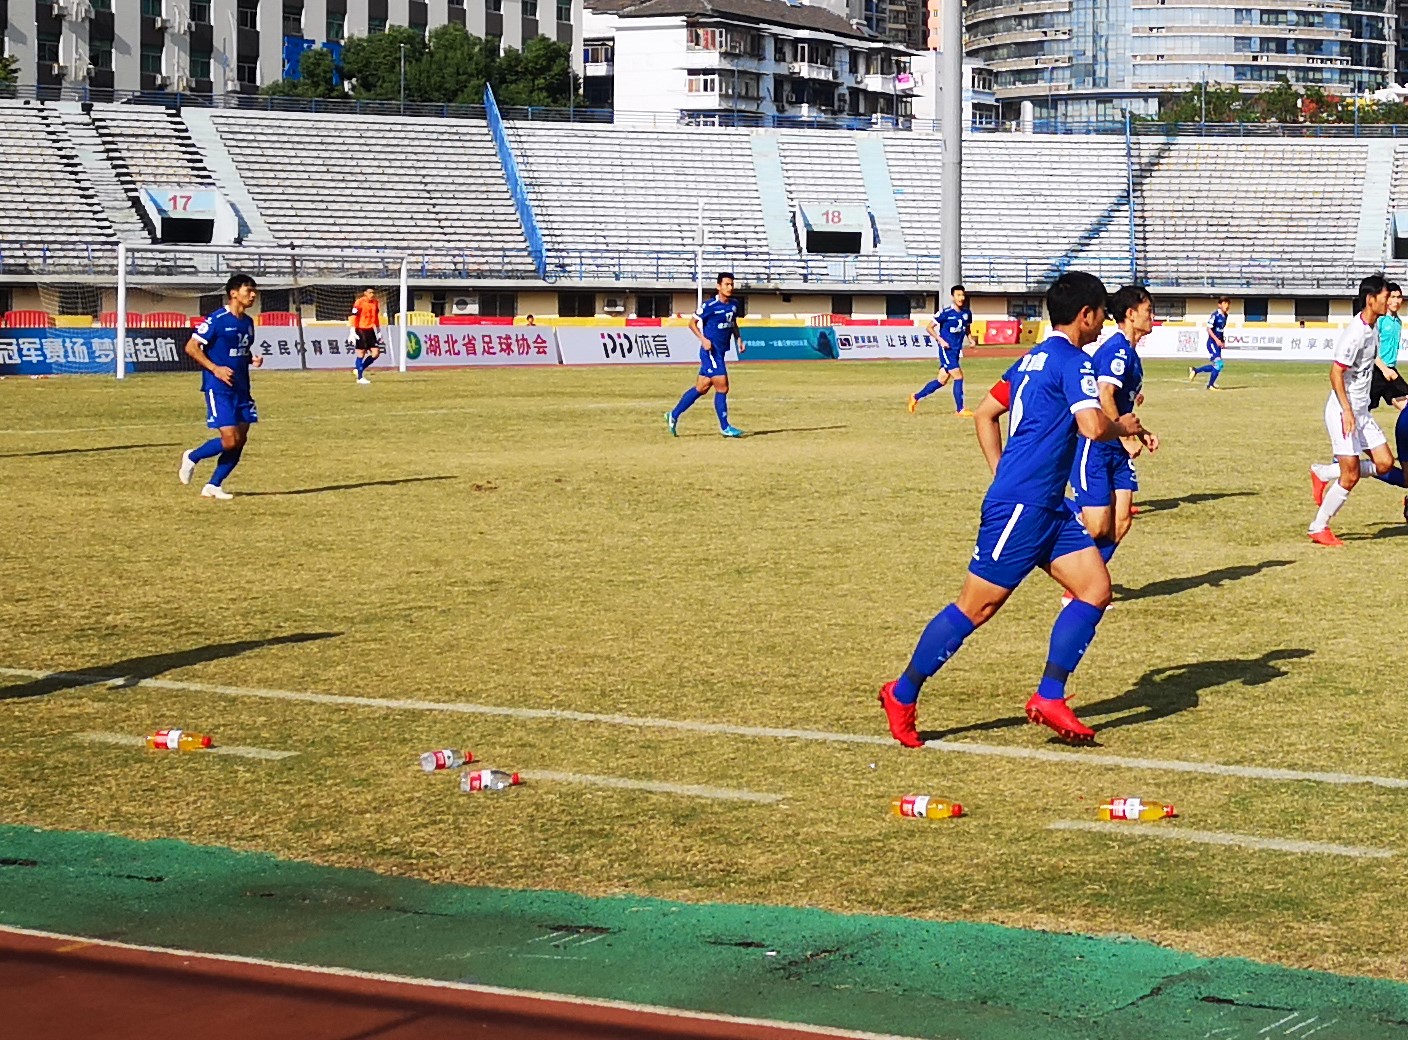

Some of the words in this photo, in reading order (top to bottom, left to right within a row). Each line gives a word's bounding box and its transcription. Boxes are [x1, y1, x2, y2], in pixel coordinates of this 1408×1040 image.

[168, 195, 192, 211] 17
[821, 210, 842, 224] 18
[424, 333, 548, 356] 湖北省足球协会
